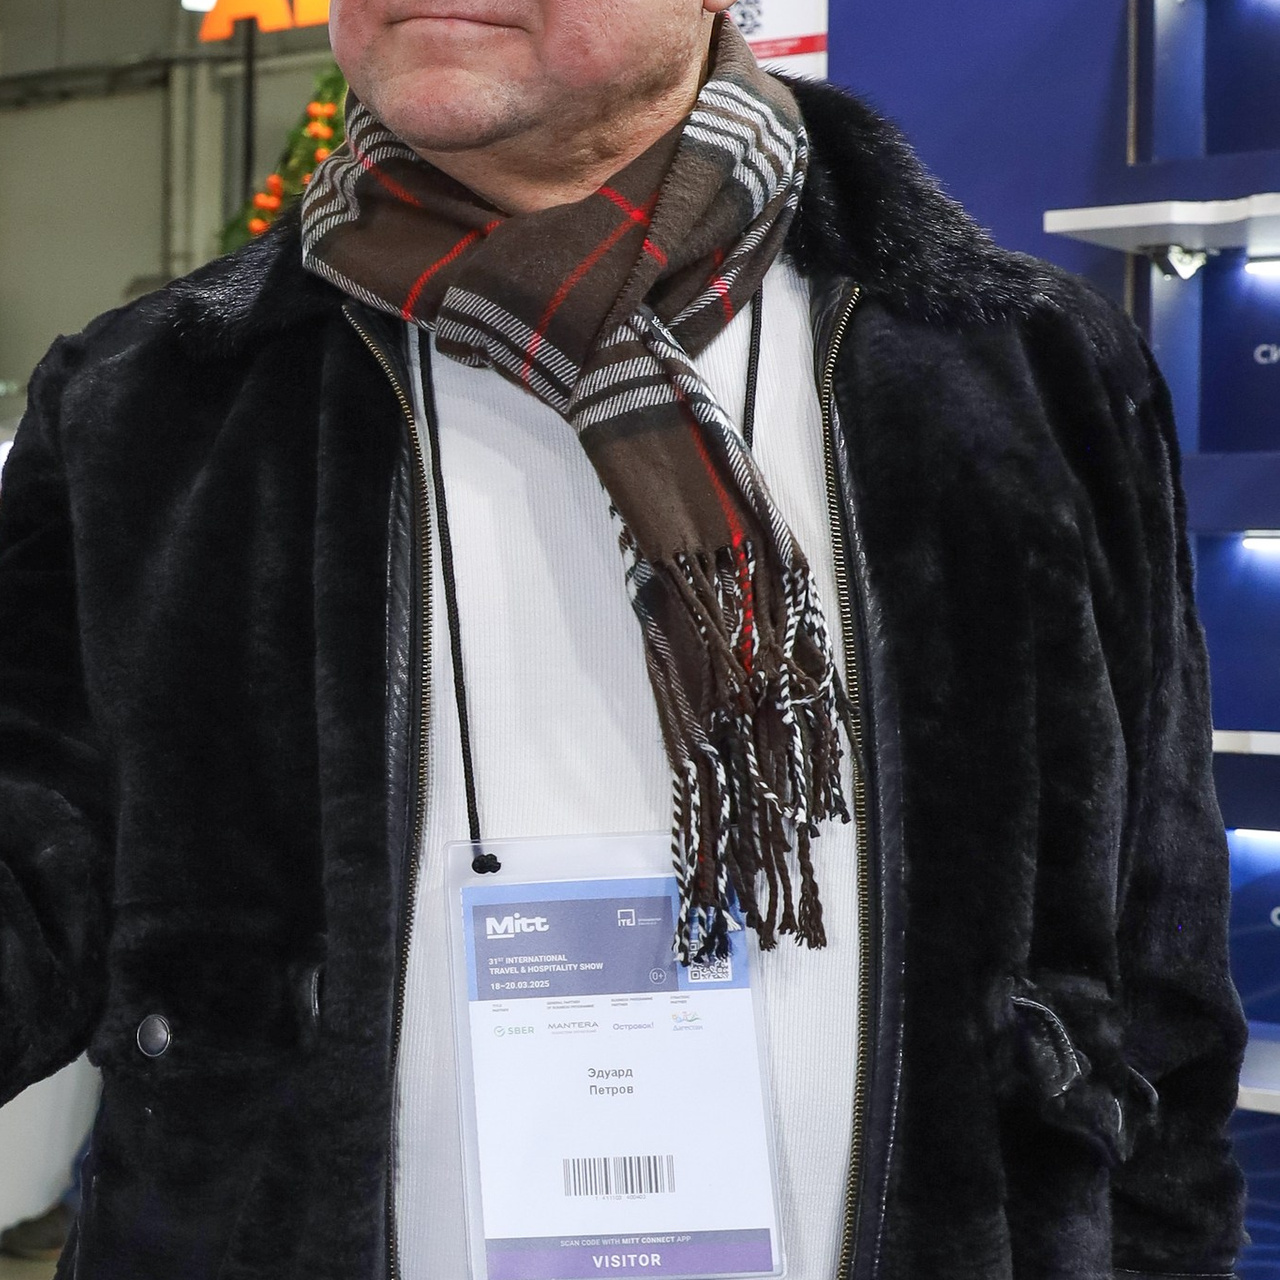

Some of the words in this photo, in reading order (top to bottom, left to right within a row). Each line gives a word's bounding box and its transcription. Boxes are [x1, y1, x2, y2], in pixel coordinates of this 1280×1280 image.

[486, 912, 549, 936] Mitt
[505, 954, 568, 964] INTERNATIONAL
[490, 966, 519, 975] TRAVEL
[527, 963, 578, 973] HOSPITALITY
[580, 962, 604, 970] SHOW
[547, 1021, 599, 1029] MANTERA
[612, 1022, 654, 1031] Островок!
[507, 1026, 535, 1035] SBER
[588, 1068, 633, 1079] Эдуард
[590, 1085, 634, 1096] Петров
[641, 1236, 675, 1244] CONNECT
[592, 1253, 661, 1268] VISITOR
